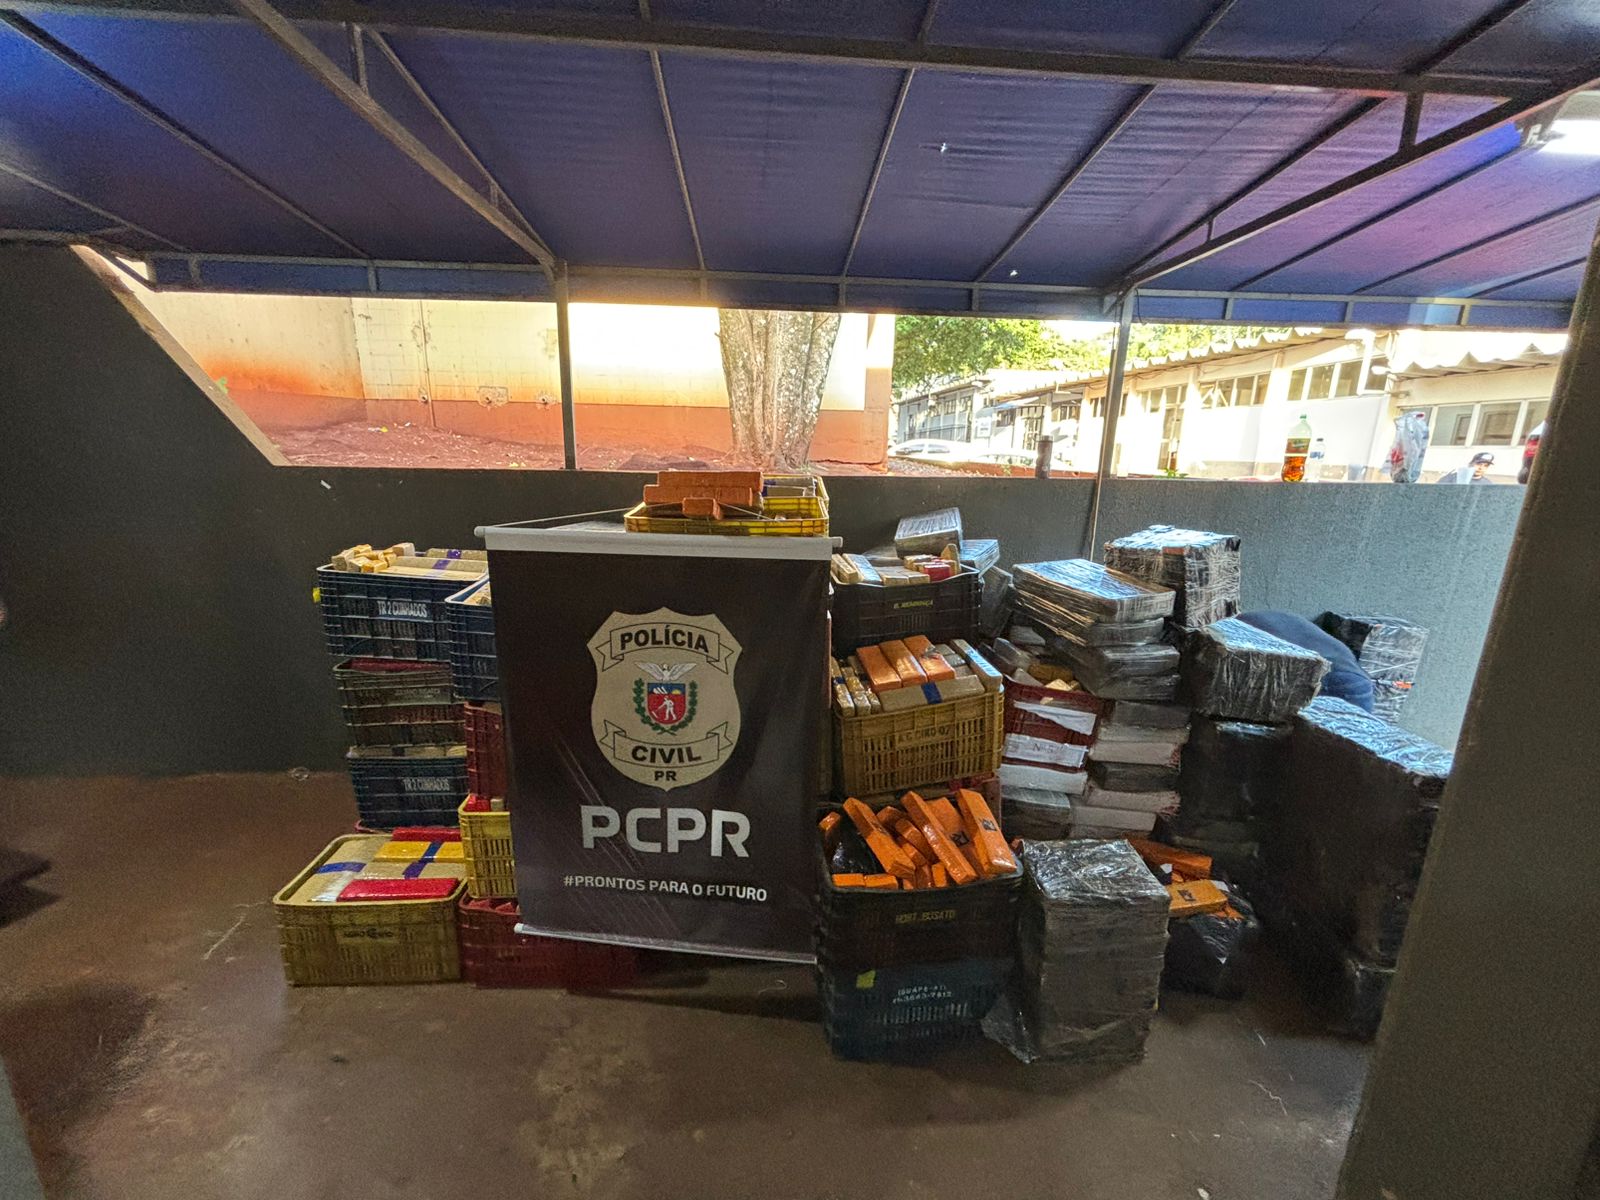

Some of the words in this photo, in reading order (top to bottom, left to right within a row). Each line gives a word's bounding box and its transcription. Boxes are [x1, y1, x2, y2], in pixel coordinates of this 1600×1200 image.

[620, 625, 709, 653] POLÍCIA
[631, 745, 702, 763] CIVIL
[654, 770, 677, 781] PR
[580, 805, 751, 857] PCPR
[563, 875, 646, 891] #PRONTOS
[649, 880, 689, 894] PARA
[692, 884, 703, 896] O
[706, 885, 768, 901] FUTURO
